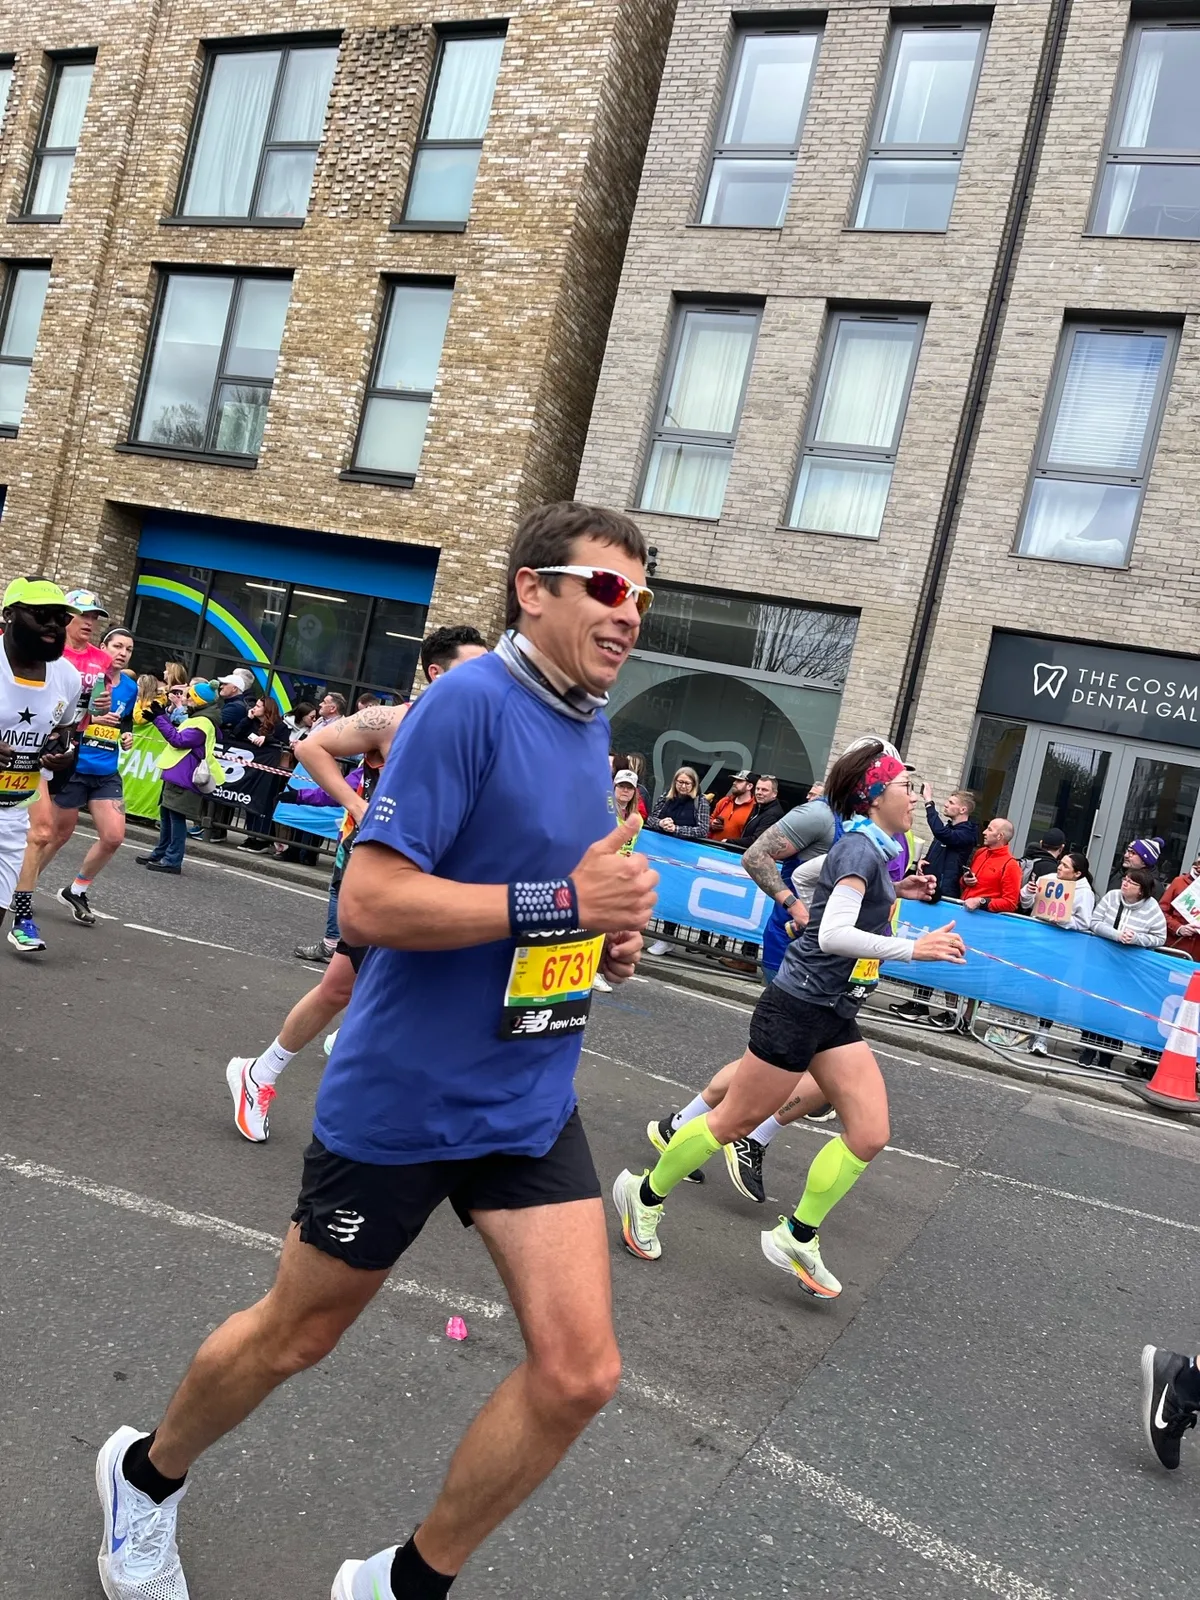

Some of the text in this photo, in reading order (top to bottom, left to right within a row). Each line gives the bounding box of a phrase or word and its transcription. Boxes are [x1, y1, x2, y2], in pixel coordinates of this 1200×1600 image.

[1078, 668, 1198, 701] THE COSM
[1072, 689, 1198, 722] DENTAL GAL
[94, 726, 115, 740] 6322
[1044, 882, 1064, 899] GO
[1037, 900, 1066, 918] DAD
[542, 950, 593, 991] 6731
[549, 1019, 569, 1031] new
